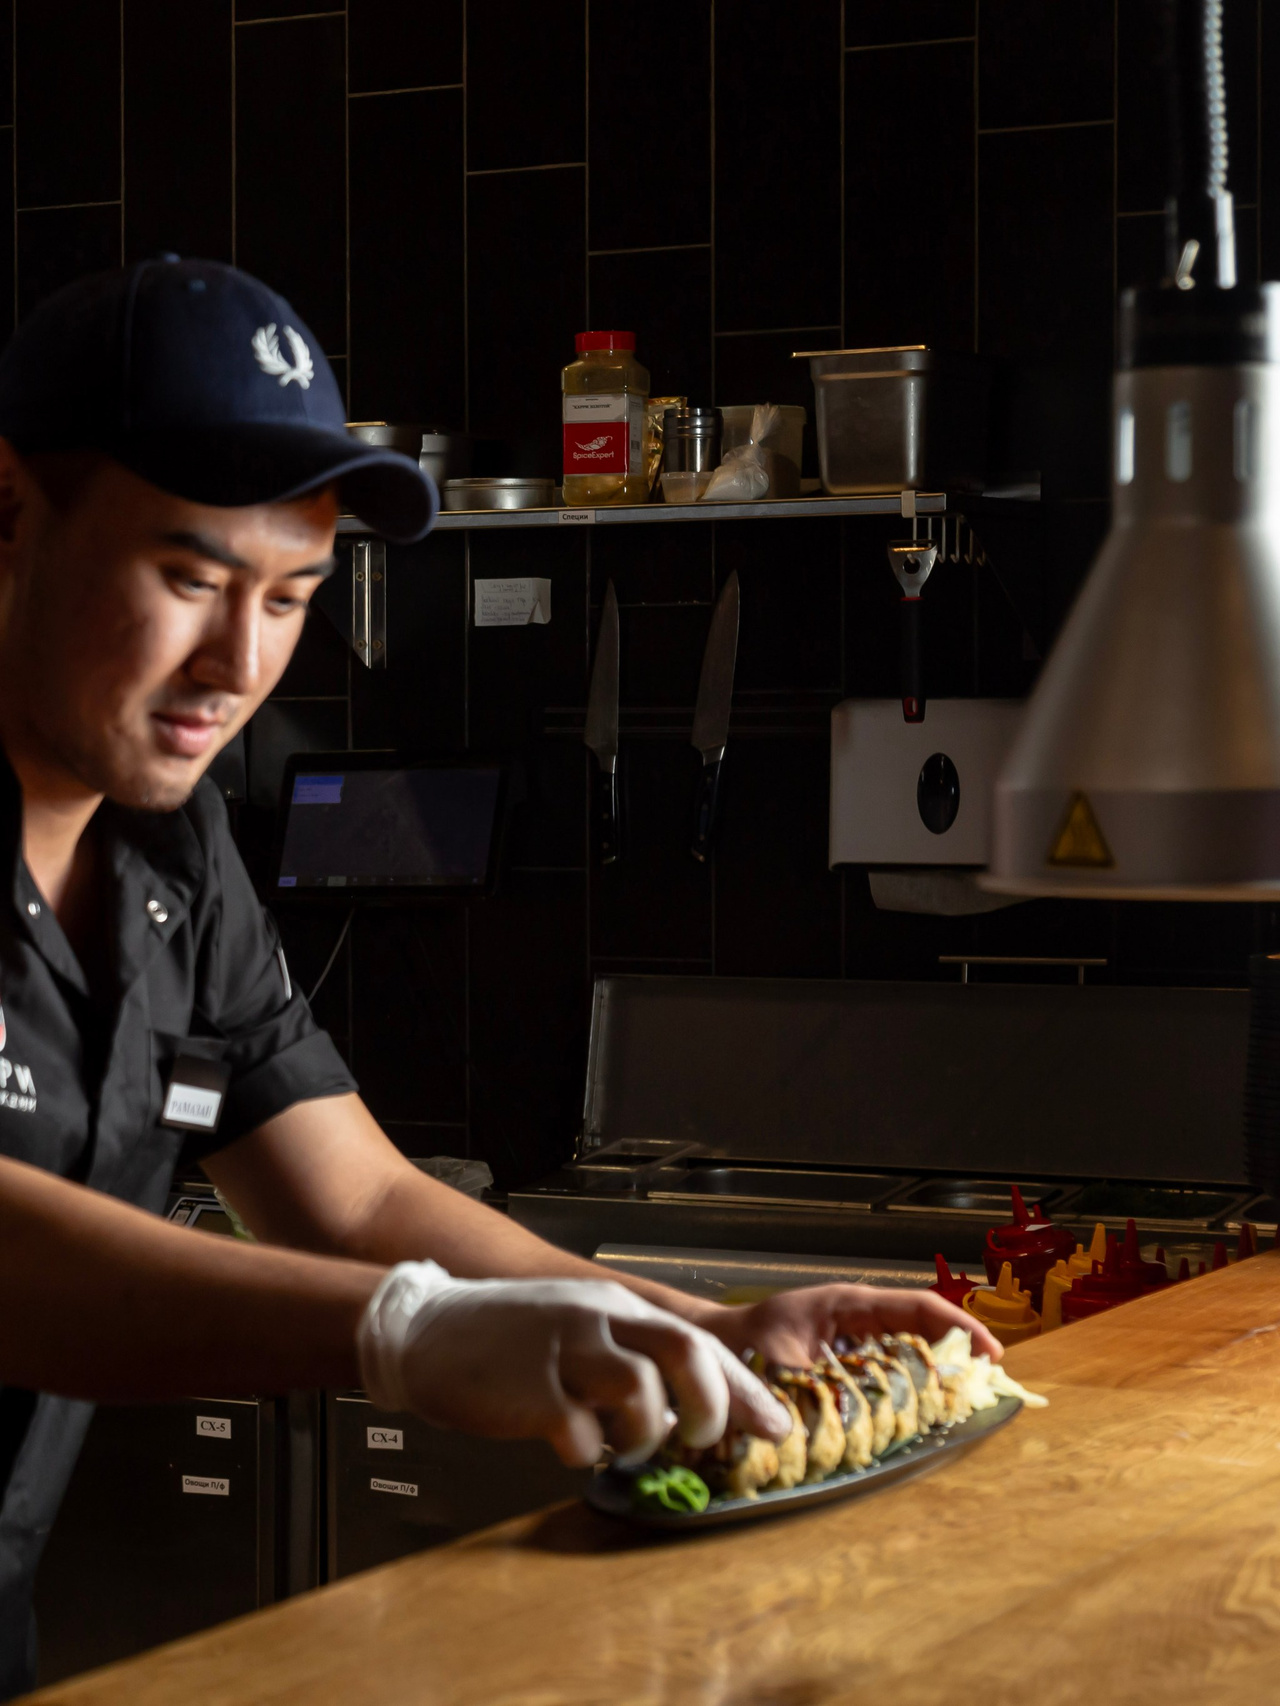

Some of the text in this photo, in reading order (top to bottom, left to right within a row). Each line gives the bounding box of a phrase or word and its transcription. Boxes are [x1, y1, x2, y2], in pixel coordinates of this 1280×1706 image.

[573, 451, 614, 460] SpiceExpert
[562, 513, 589, 521] Специи
[200, 1420, 226, 1432] СХ-5
[371, 1432, 398, 1443] СХ-4
[184, 1478, 209, 1488] Овощи
[372, 1480, 399, 1491] Овощи
